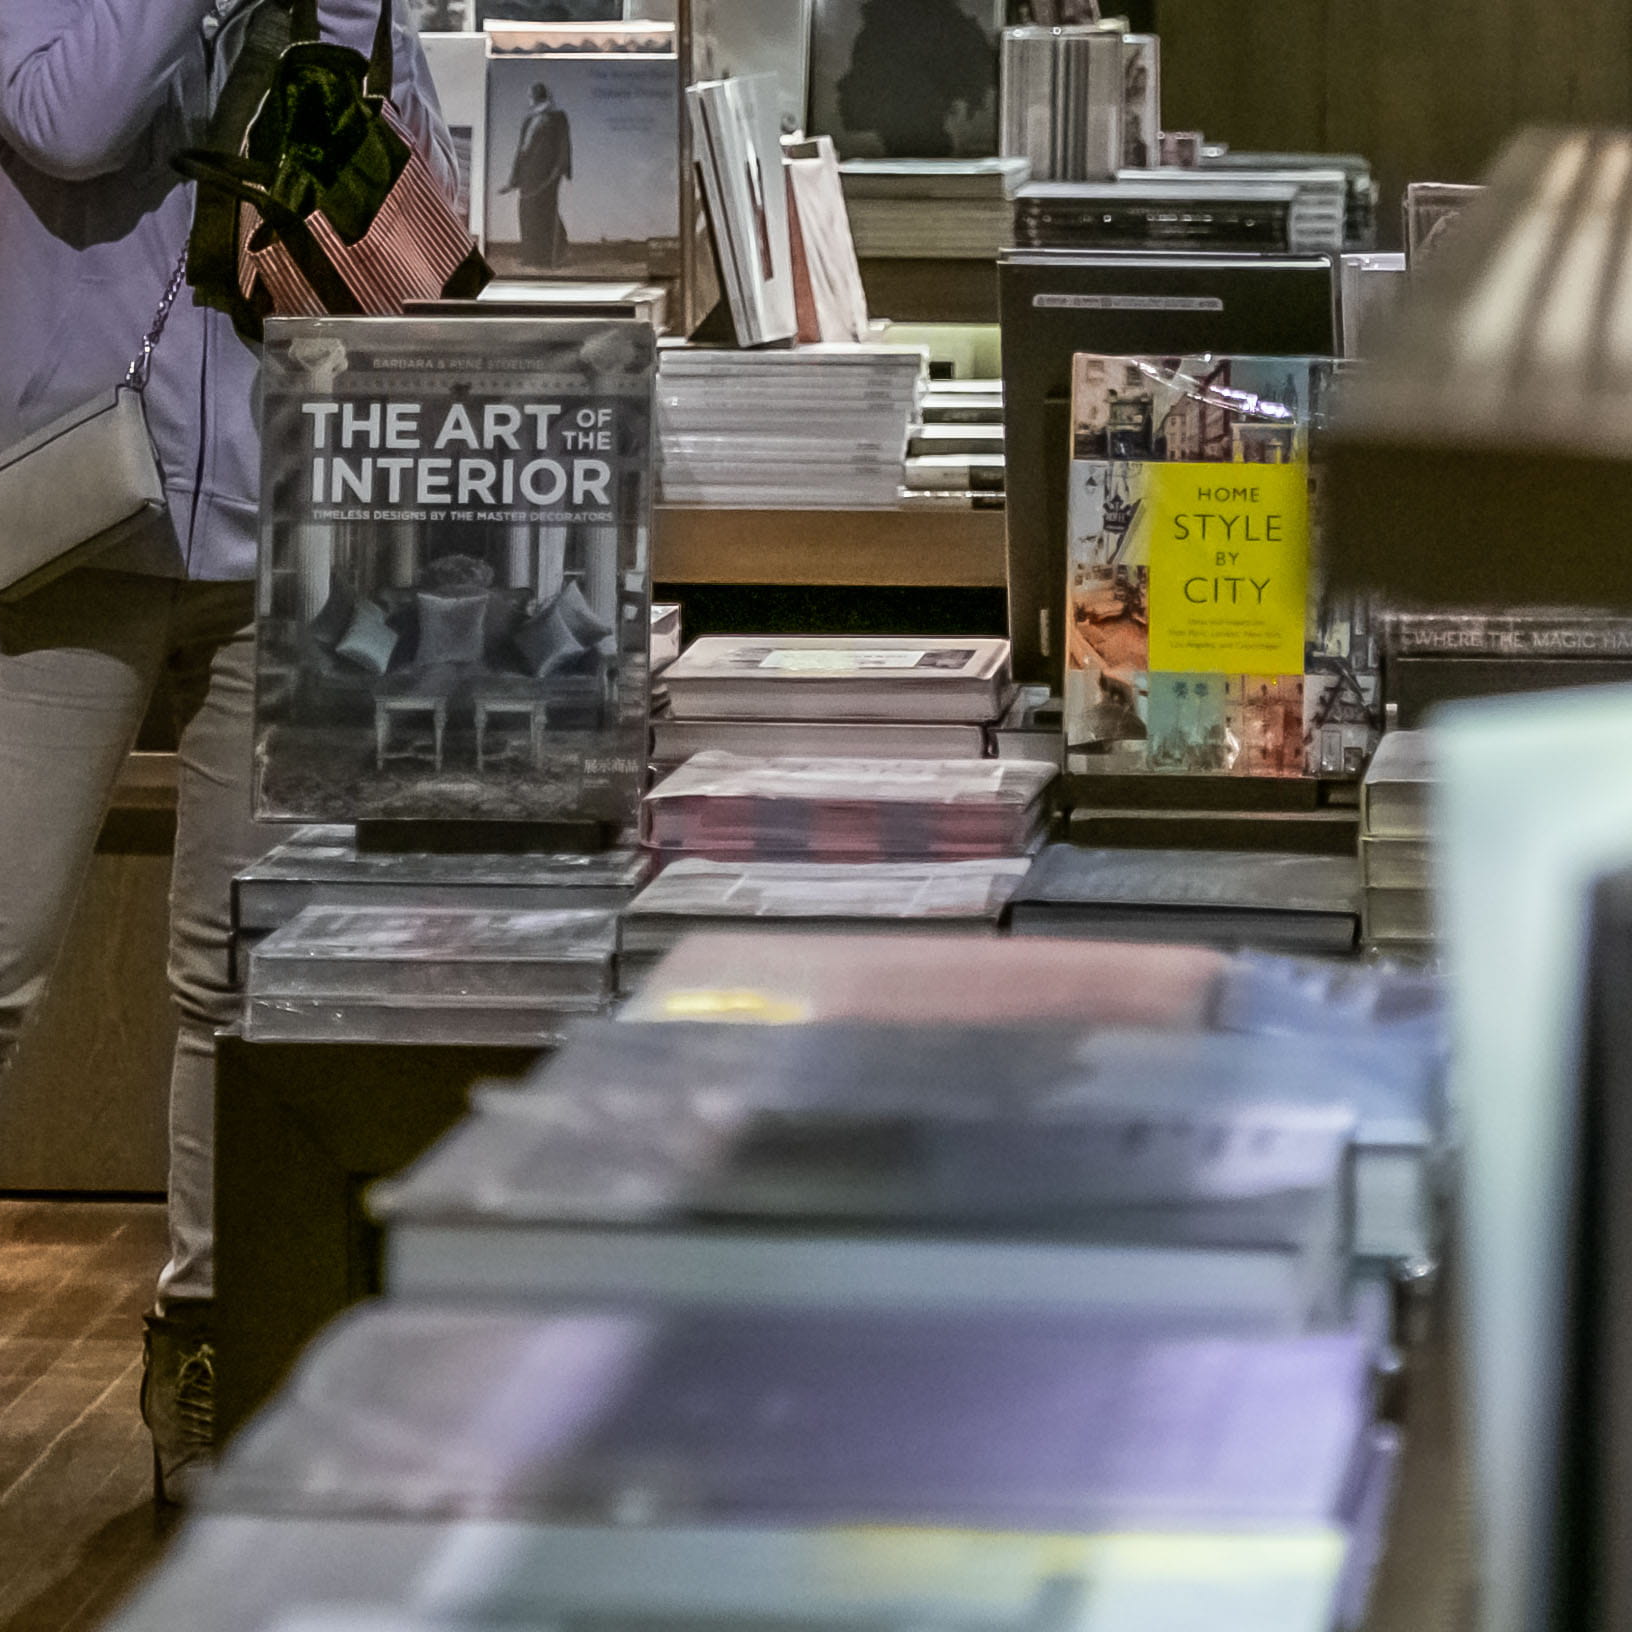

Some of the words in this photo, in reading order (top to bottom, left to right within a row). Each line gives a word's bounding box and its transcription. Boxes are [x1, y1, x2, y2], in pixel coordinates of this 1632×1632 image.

[301, 402, 421, 449] THE
[433, 403, 562, 450] ART
[575, 408, 613, 428] OF
[561, 430, 612, 451] THE
[311, 457, 611, 506] INTERIOR
[1197, 487, 1260, 503] HOME
[312, 510, 370, 521] TIMELESS
[372, 510, 427, 521] DESIGNS
[429, 510, 446, 521] BY
[449, 510, 474, 522] THE
[476, 511, 527, 522] MASTER
[528, 511, 614, 523] DECORATORS
[1174, 513, 1283, 541] STYLE
[1215, 551, 1240, 566] BY
[1184, 577, 1271, 604] CITY
[1415, 630, 1483, 648] WHERE
[1486, 631, 1524, 648] THE
[1532, 631, 1596, 649] MAGIC
